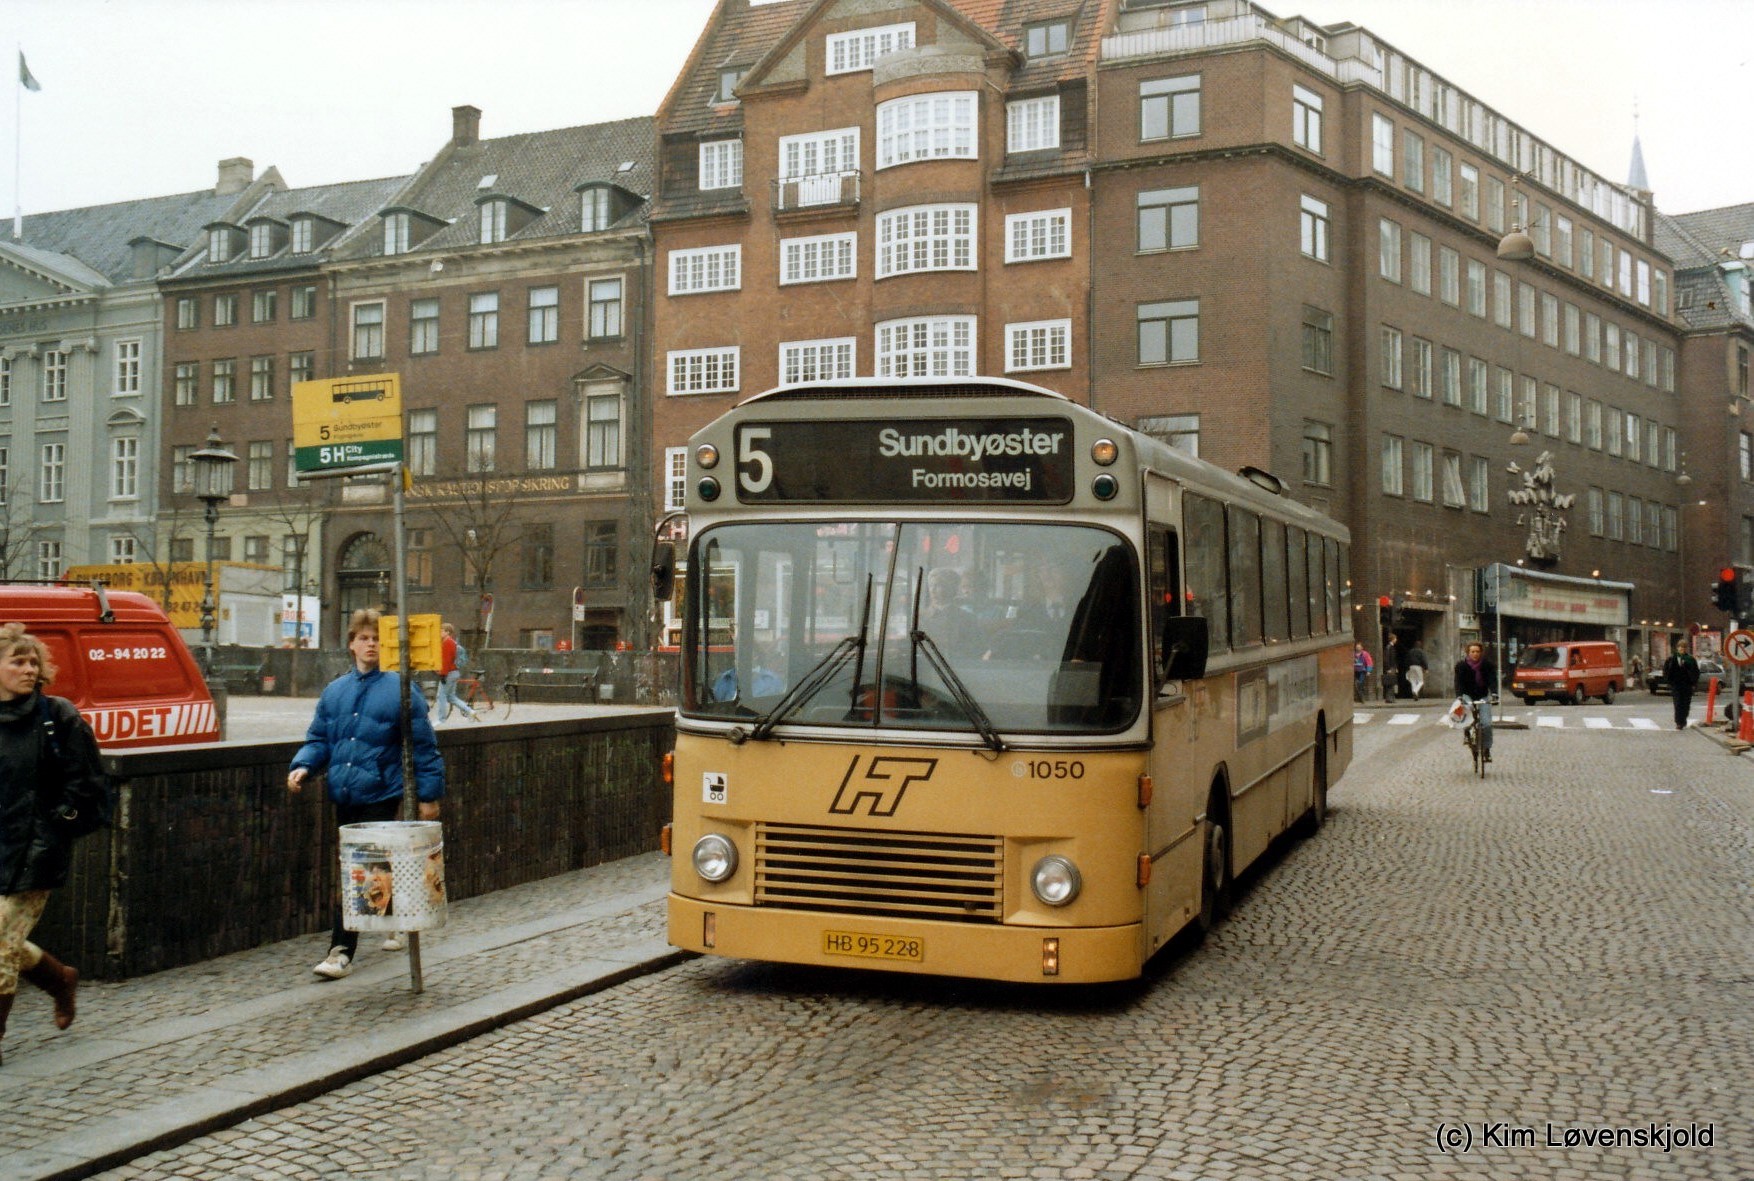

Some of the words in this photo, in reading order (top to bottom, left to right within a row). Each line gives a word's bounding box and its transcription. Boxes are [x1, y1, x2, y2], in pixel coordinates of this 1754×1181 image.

[320, 425, 331, 440] 5
[345, 445, 362, 455] City
[878, 428, 1064, 461] Sundbyøster
[739, 427, 774, 493] 5
[912, 468, 1031, 491] Formosavej
[133, 647, 149, 659] 20
[150, 647, 166, 659] 22
[1028, 761, 1085, 779] 1050
[827, 754, 939, 817] HT
[827, 934, 853, 952] HB
[857, 936, 880, 954] 95
[884, 939, 919, 958] 228
